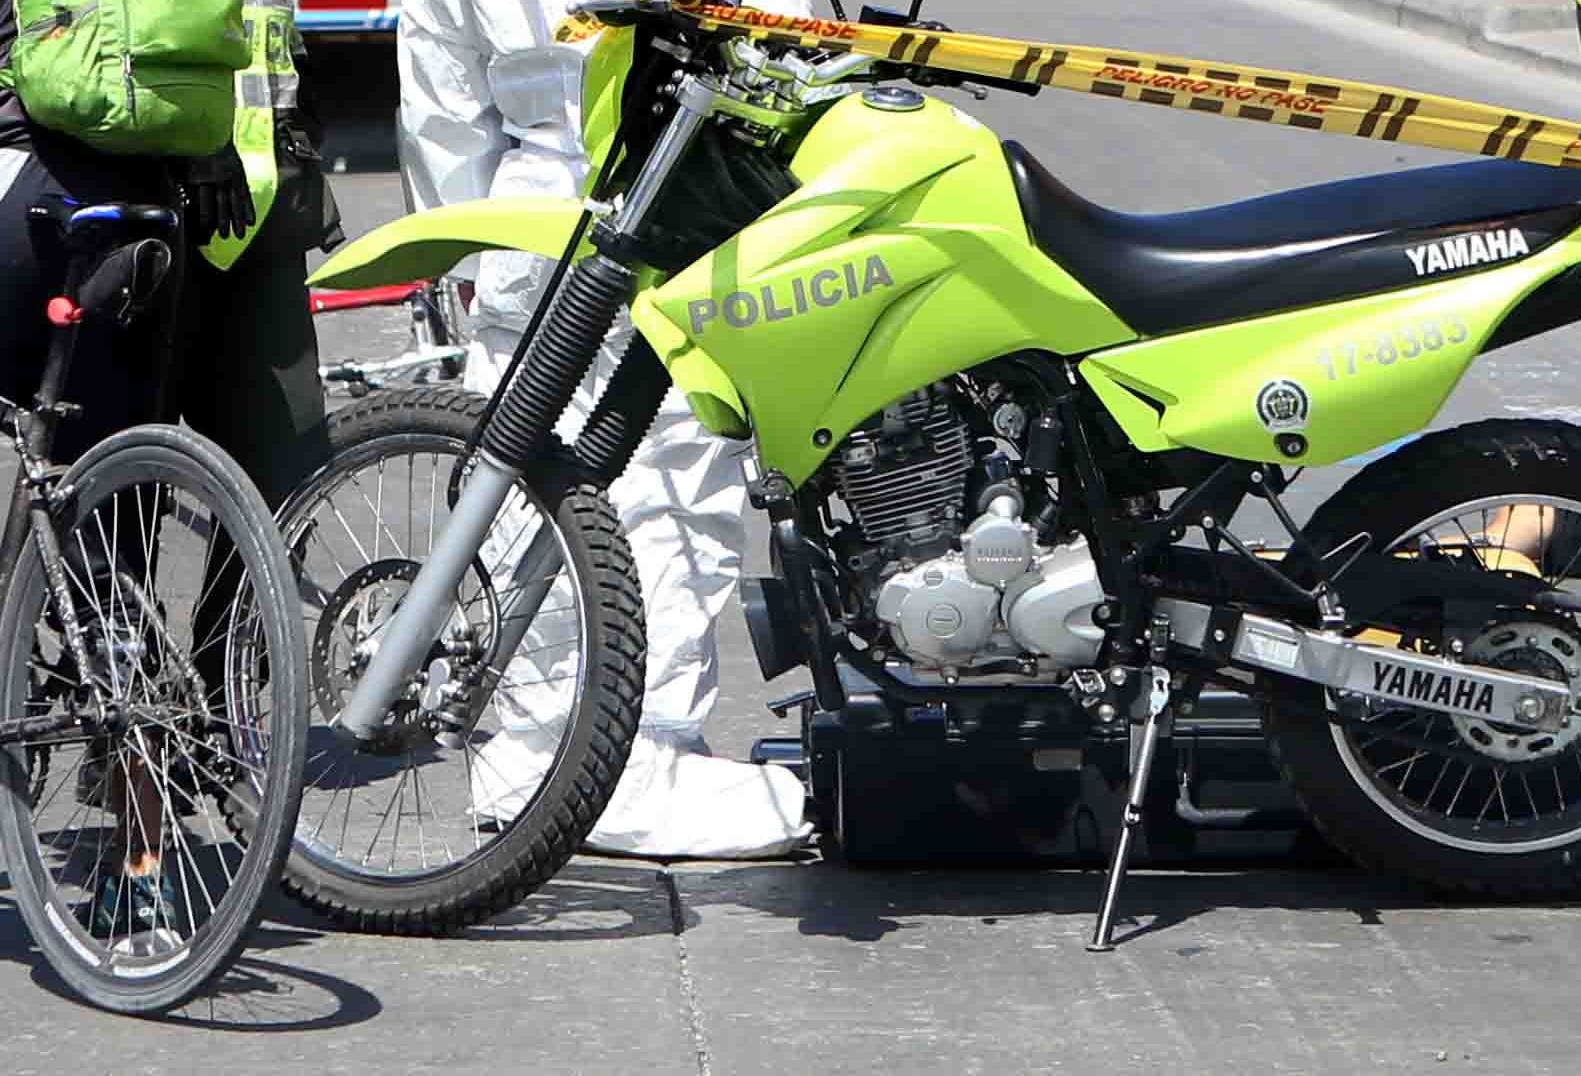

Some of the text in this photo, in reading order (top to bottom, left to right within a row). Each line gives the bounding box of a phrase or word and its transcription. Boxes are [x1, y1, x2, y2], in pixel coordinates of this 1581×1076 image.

[1405, 227, 1530, 276] YAMAHA
[687, 253, 895, 334] POLICIA
[1371, 661, 1496, 714] YAMAHA
